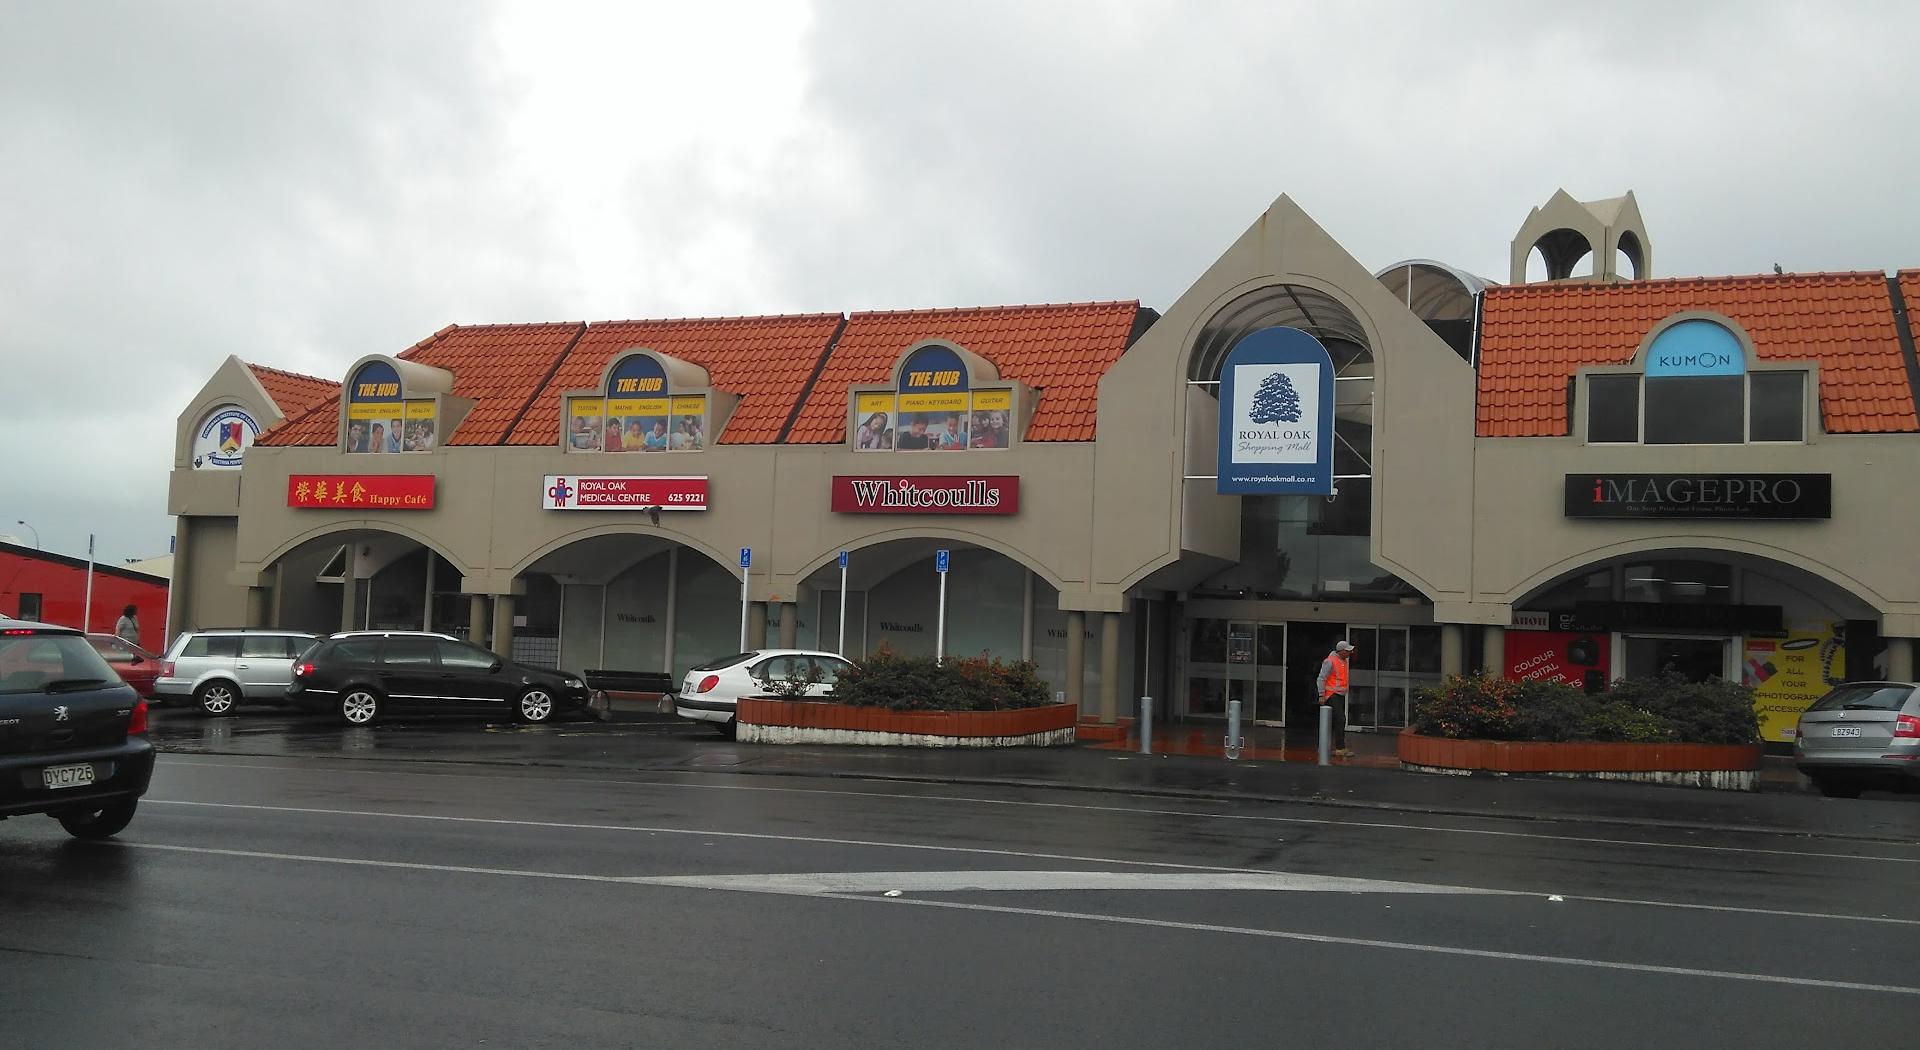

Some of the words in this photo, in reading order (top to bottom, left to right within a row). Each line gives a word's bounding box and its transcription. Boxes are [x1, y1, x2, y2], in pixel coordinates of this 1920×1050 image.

[1659, 352, 1731, 368] KUMON
[616, 378, 638, 393] THE
[637, 377, 663, 392] HUB
[907, 371, 932, 387] THE
[932, 370, 961, 386] HUB
[358, 383, 378, 397] THE
[376, 383, 399, 397] HUB
[928, 398, 962, 406] KEYBOARD
[1238, 430, 1280, 440] ROYAL
[1283, 430, 1312, 440] OAK
[1238, 441, 1283, 455] Shopping
[1287, 441, 1312, 452] Mall
[580, 481, 606, 491] ROYAL
[607, 481, 627, 491] OAK
[1231, 475, 1316, 484] www.royaloakmall.co.nz
[295, 480, 366, 503] 榮華美食
[579, 493, 615, 502] MEDICAL
[618, 493, 651, 502] CENTRE
[668, 493, 683, 502] 625
[685, 493, 704, 502] 9221
[851, 478, 1000, 508] Whitcoulls
[1592, 478, 1802, 504] iMAGEPRO
[369, 494, 401, 506] Happy
[404, 493, 427, 504] Café
[615, 613, 657, 624] Whitcoulls
[880, 622, 924, 633] Whitcoulls
[1513, 650, 1555, 673] COLOUR
[1521, 663, 1559, 682] DIGITAL
[1781, 680, 1807, 688] YOUR
[1762, 705, 1806, 713] ACCESSO
[44, 766, 94, 785] DYC726
